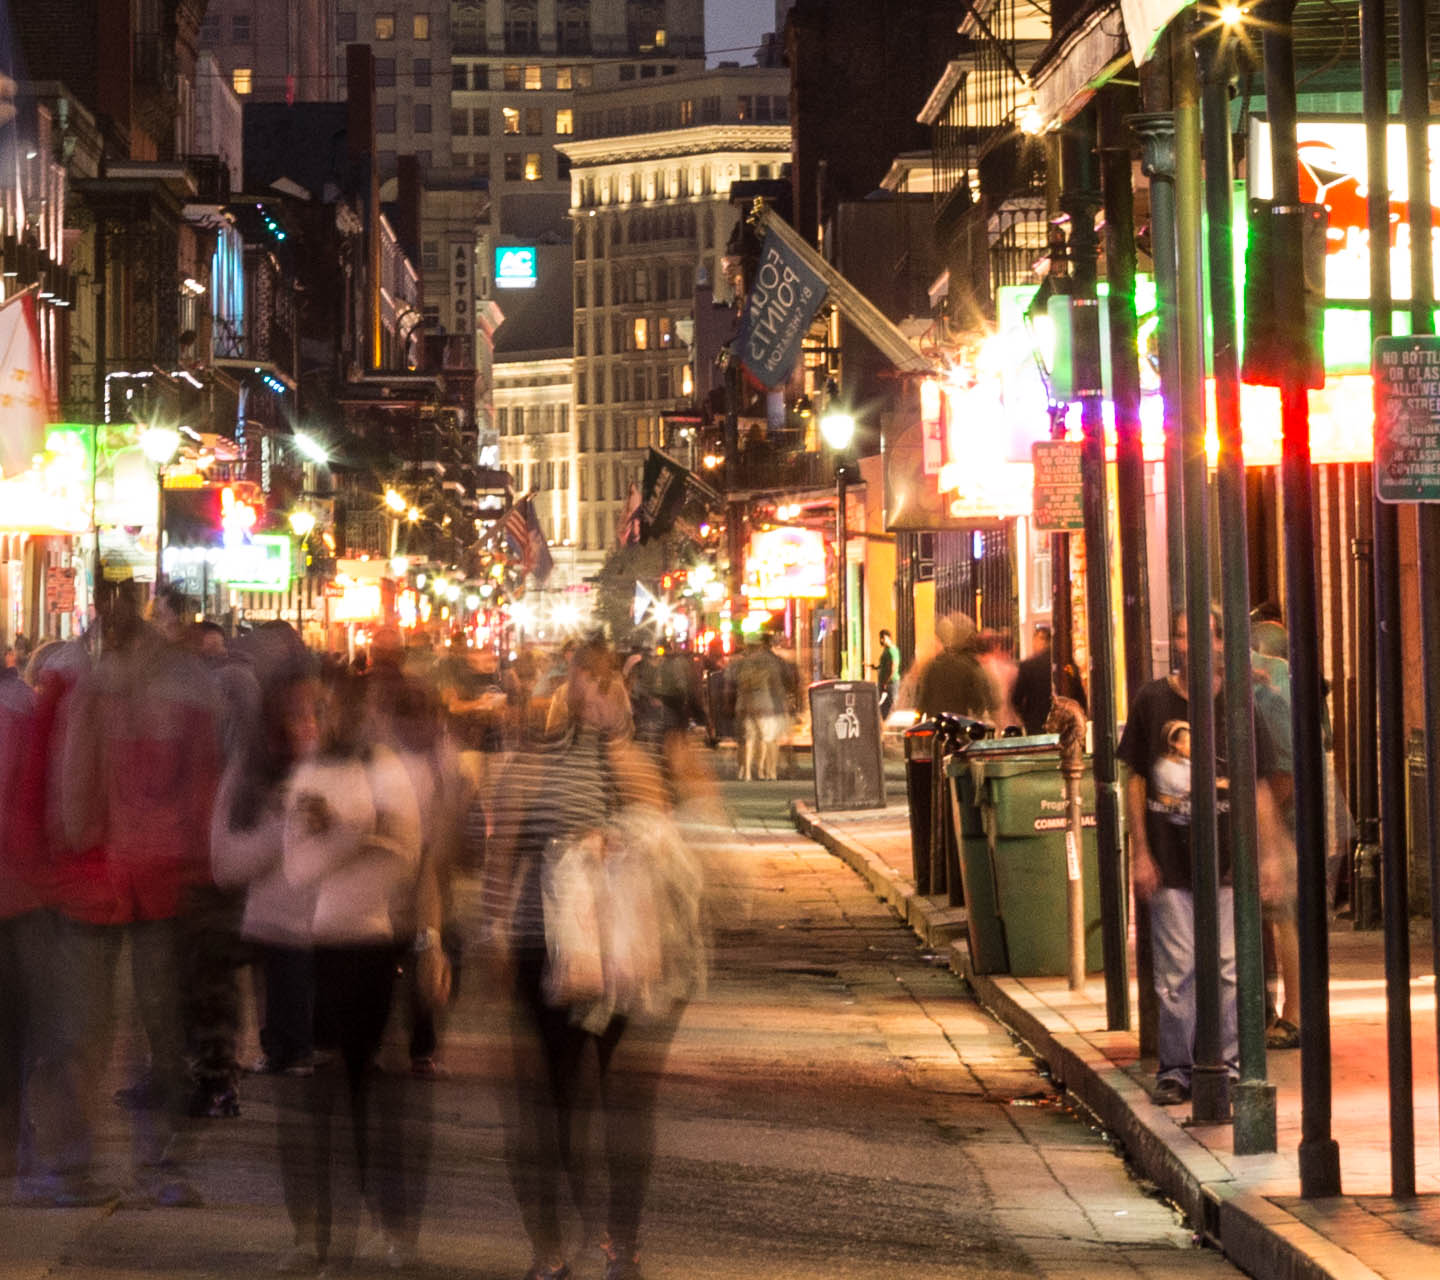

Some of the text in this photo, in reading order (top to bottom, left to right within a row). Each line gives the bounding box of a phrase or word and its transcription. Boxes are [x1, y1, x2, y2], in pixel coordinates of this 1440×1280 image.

[1383, 351, 1398, 365] NO
[1389, 367, 1404, 380] OR
[1425, 436, 1438, 448] BE
